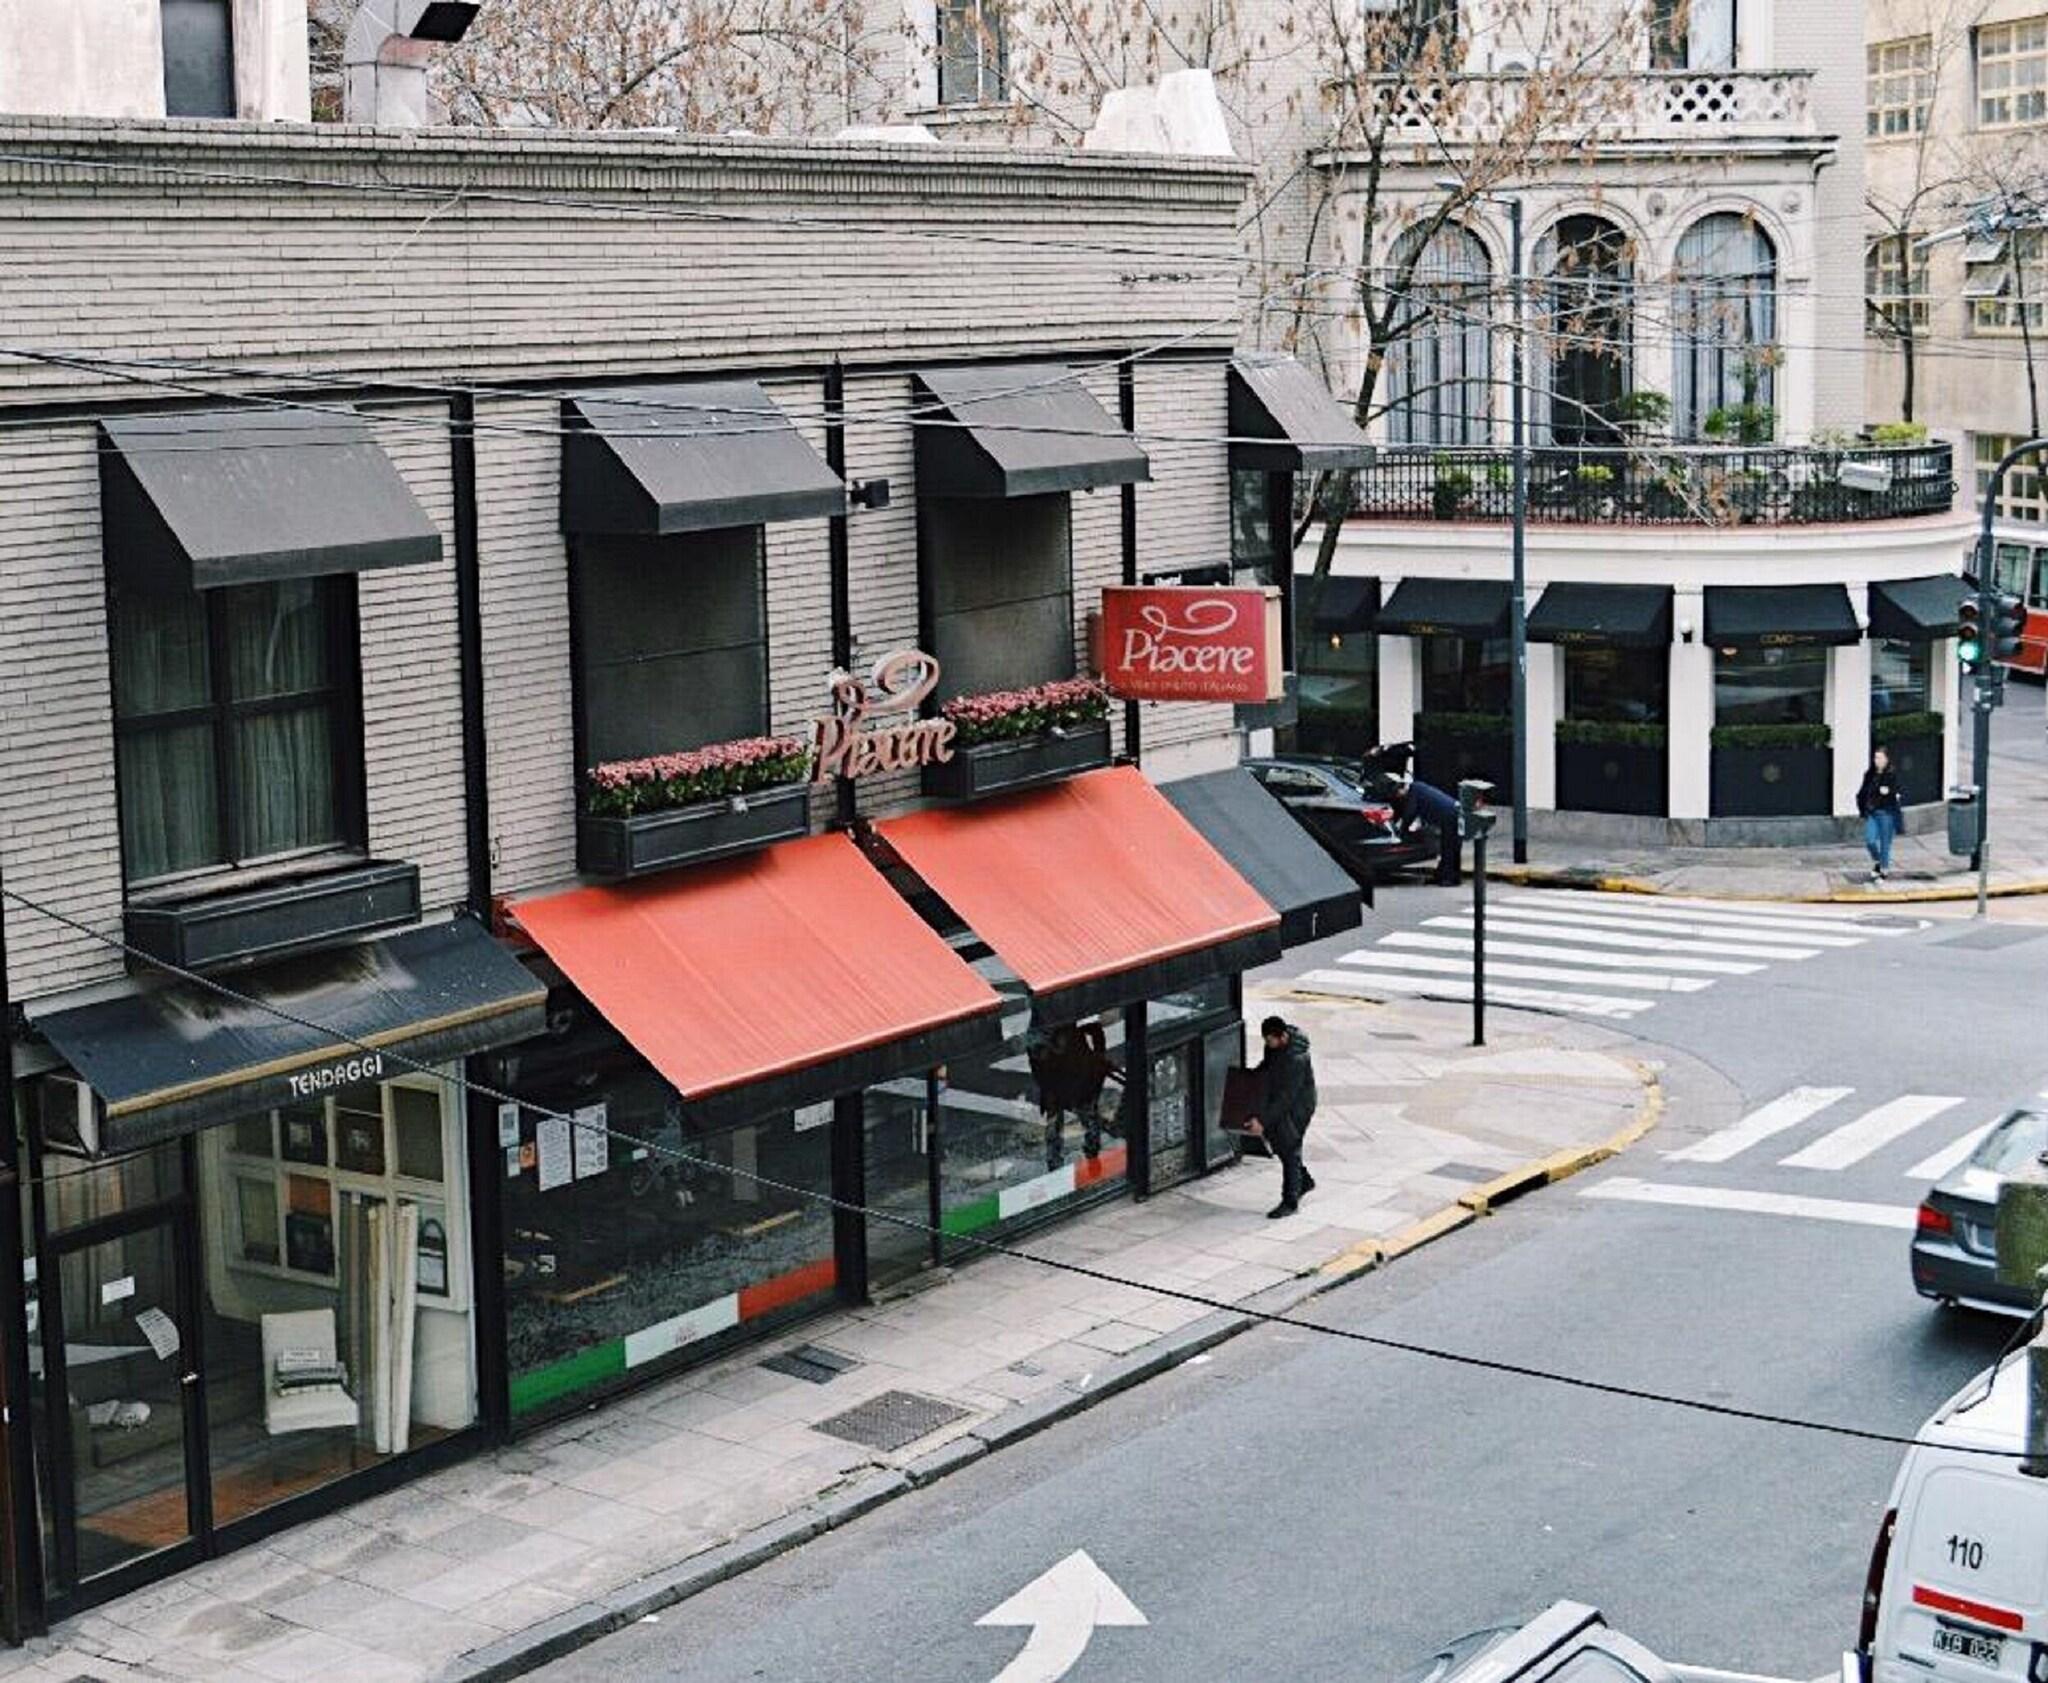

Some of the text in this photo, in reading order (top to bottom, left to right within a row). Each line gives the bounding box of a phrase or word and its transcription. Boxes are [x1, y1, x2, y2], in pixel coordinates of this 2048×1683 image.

[1117, 599, 1254, 674] Piacere
[289, 1053, 383, 1099] TENDAGGI
[1947, 1534, 1984, 1570] 110
